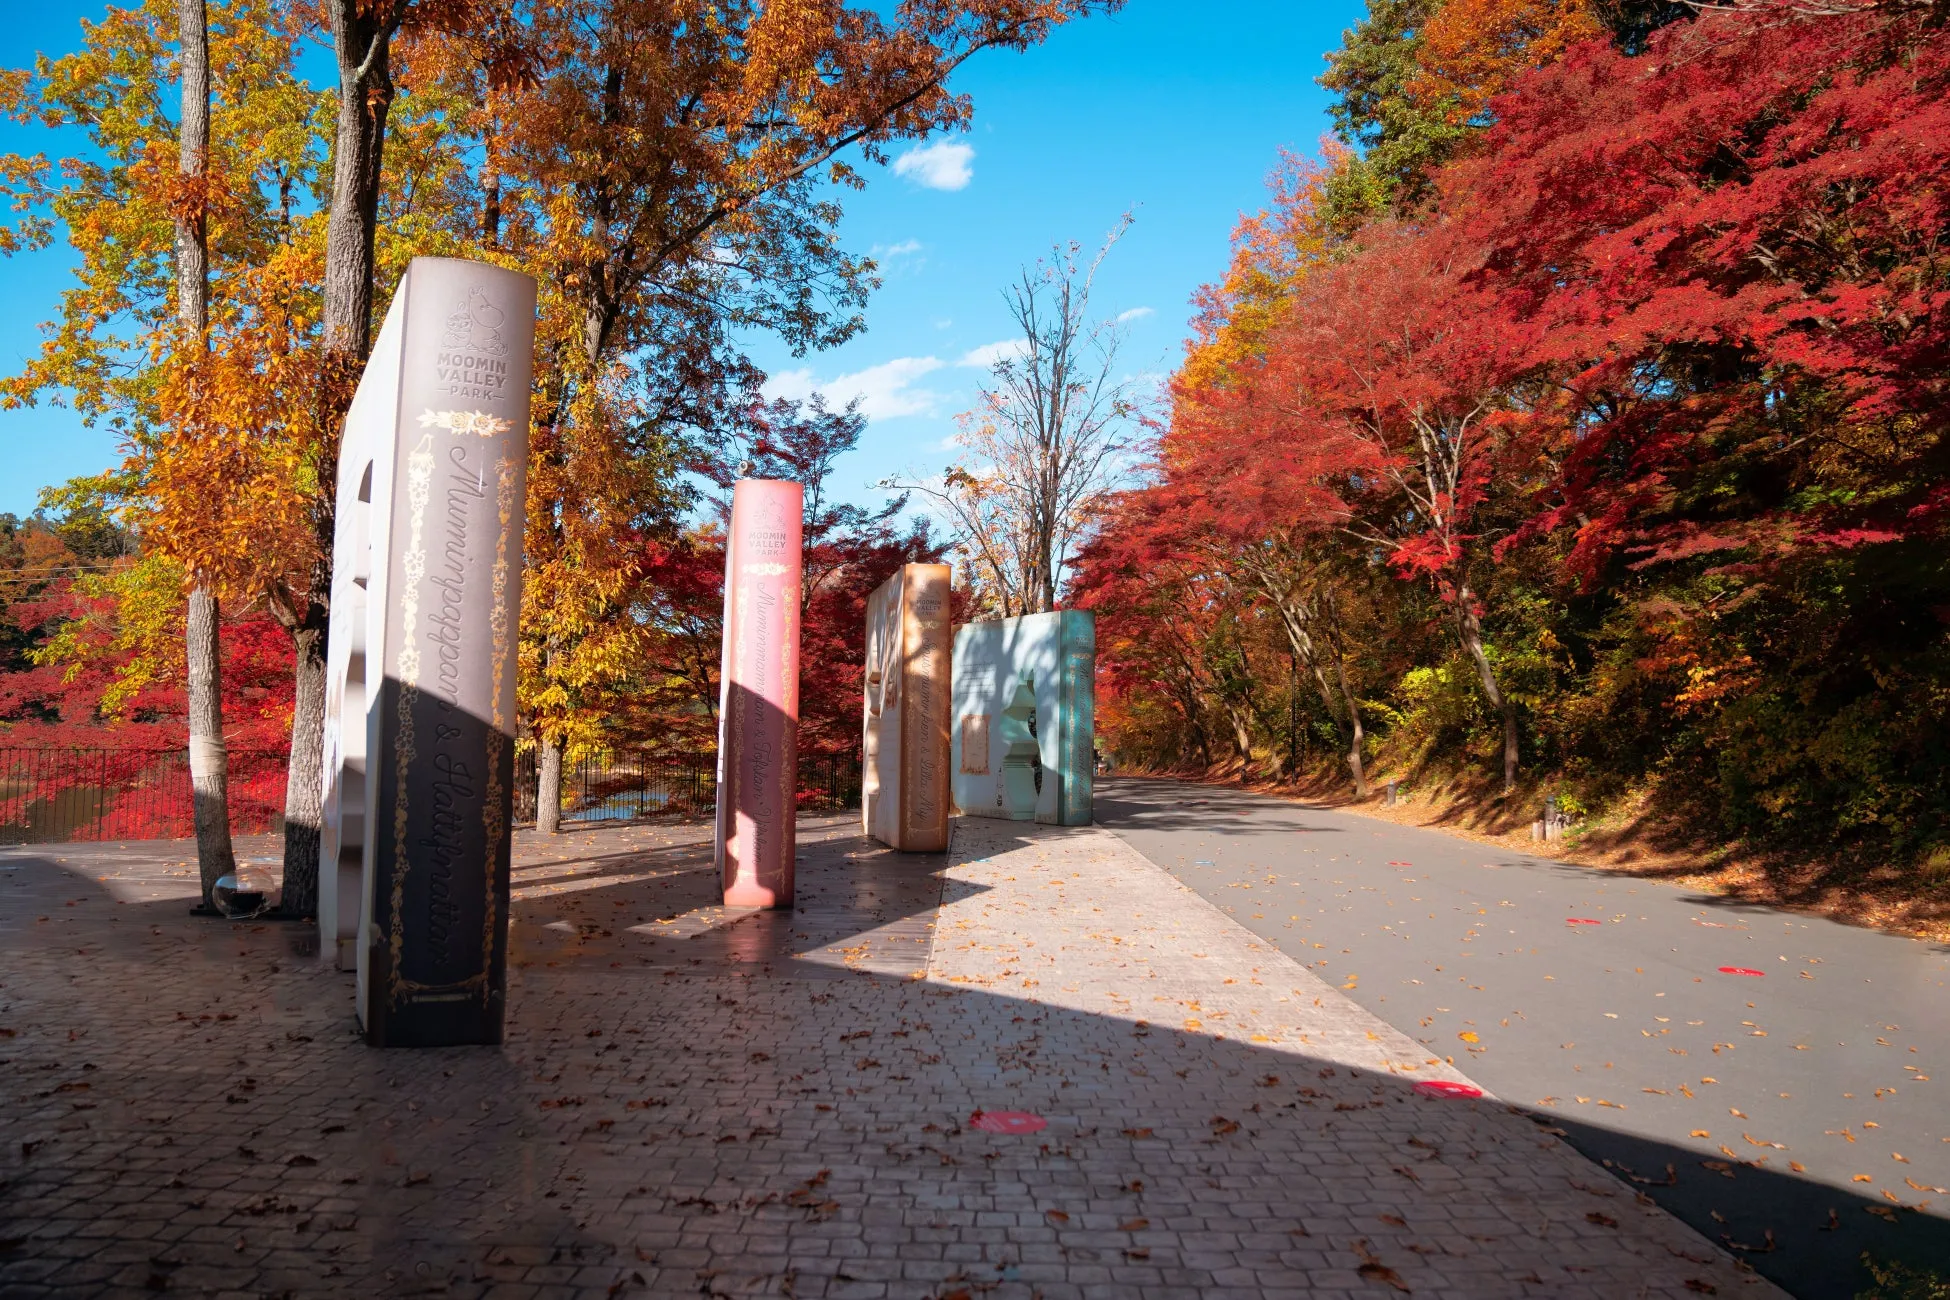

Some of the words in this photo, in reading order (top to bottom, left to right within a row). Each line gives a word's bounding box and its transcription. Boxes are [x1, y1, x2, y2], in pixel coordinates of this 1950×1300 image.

[437, 352, 507, 375] MOOMIN
[437, 367, 506, 389] VALLEY
[450, 385, 493, 401] PARK
[748, 531, 787, 541] MOOMIN
[748, 540, 786, 549] VALLEY
[427, 445, 488, 714] Muminpappan
[435, 722, 464, 745] &
